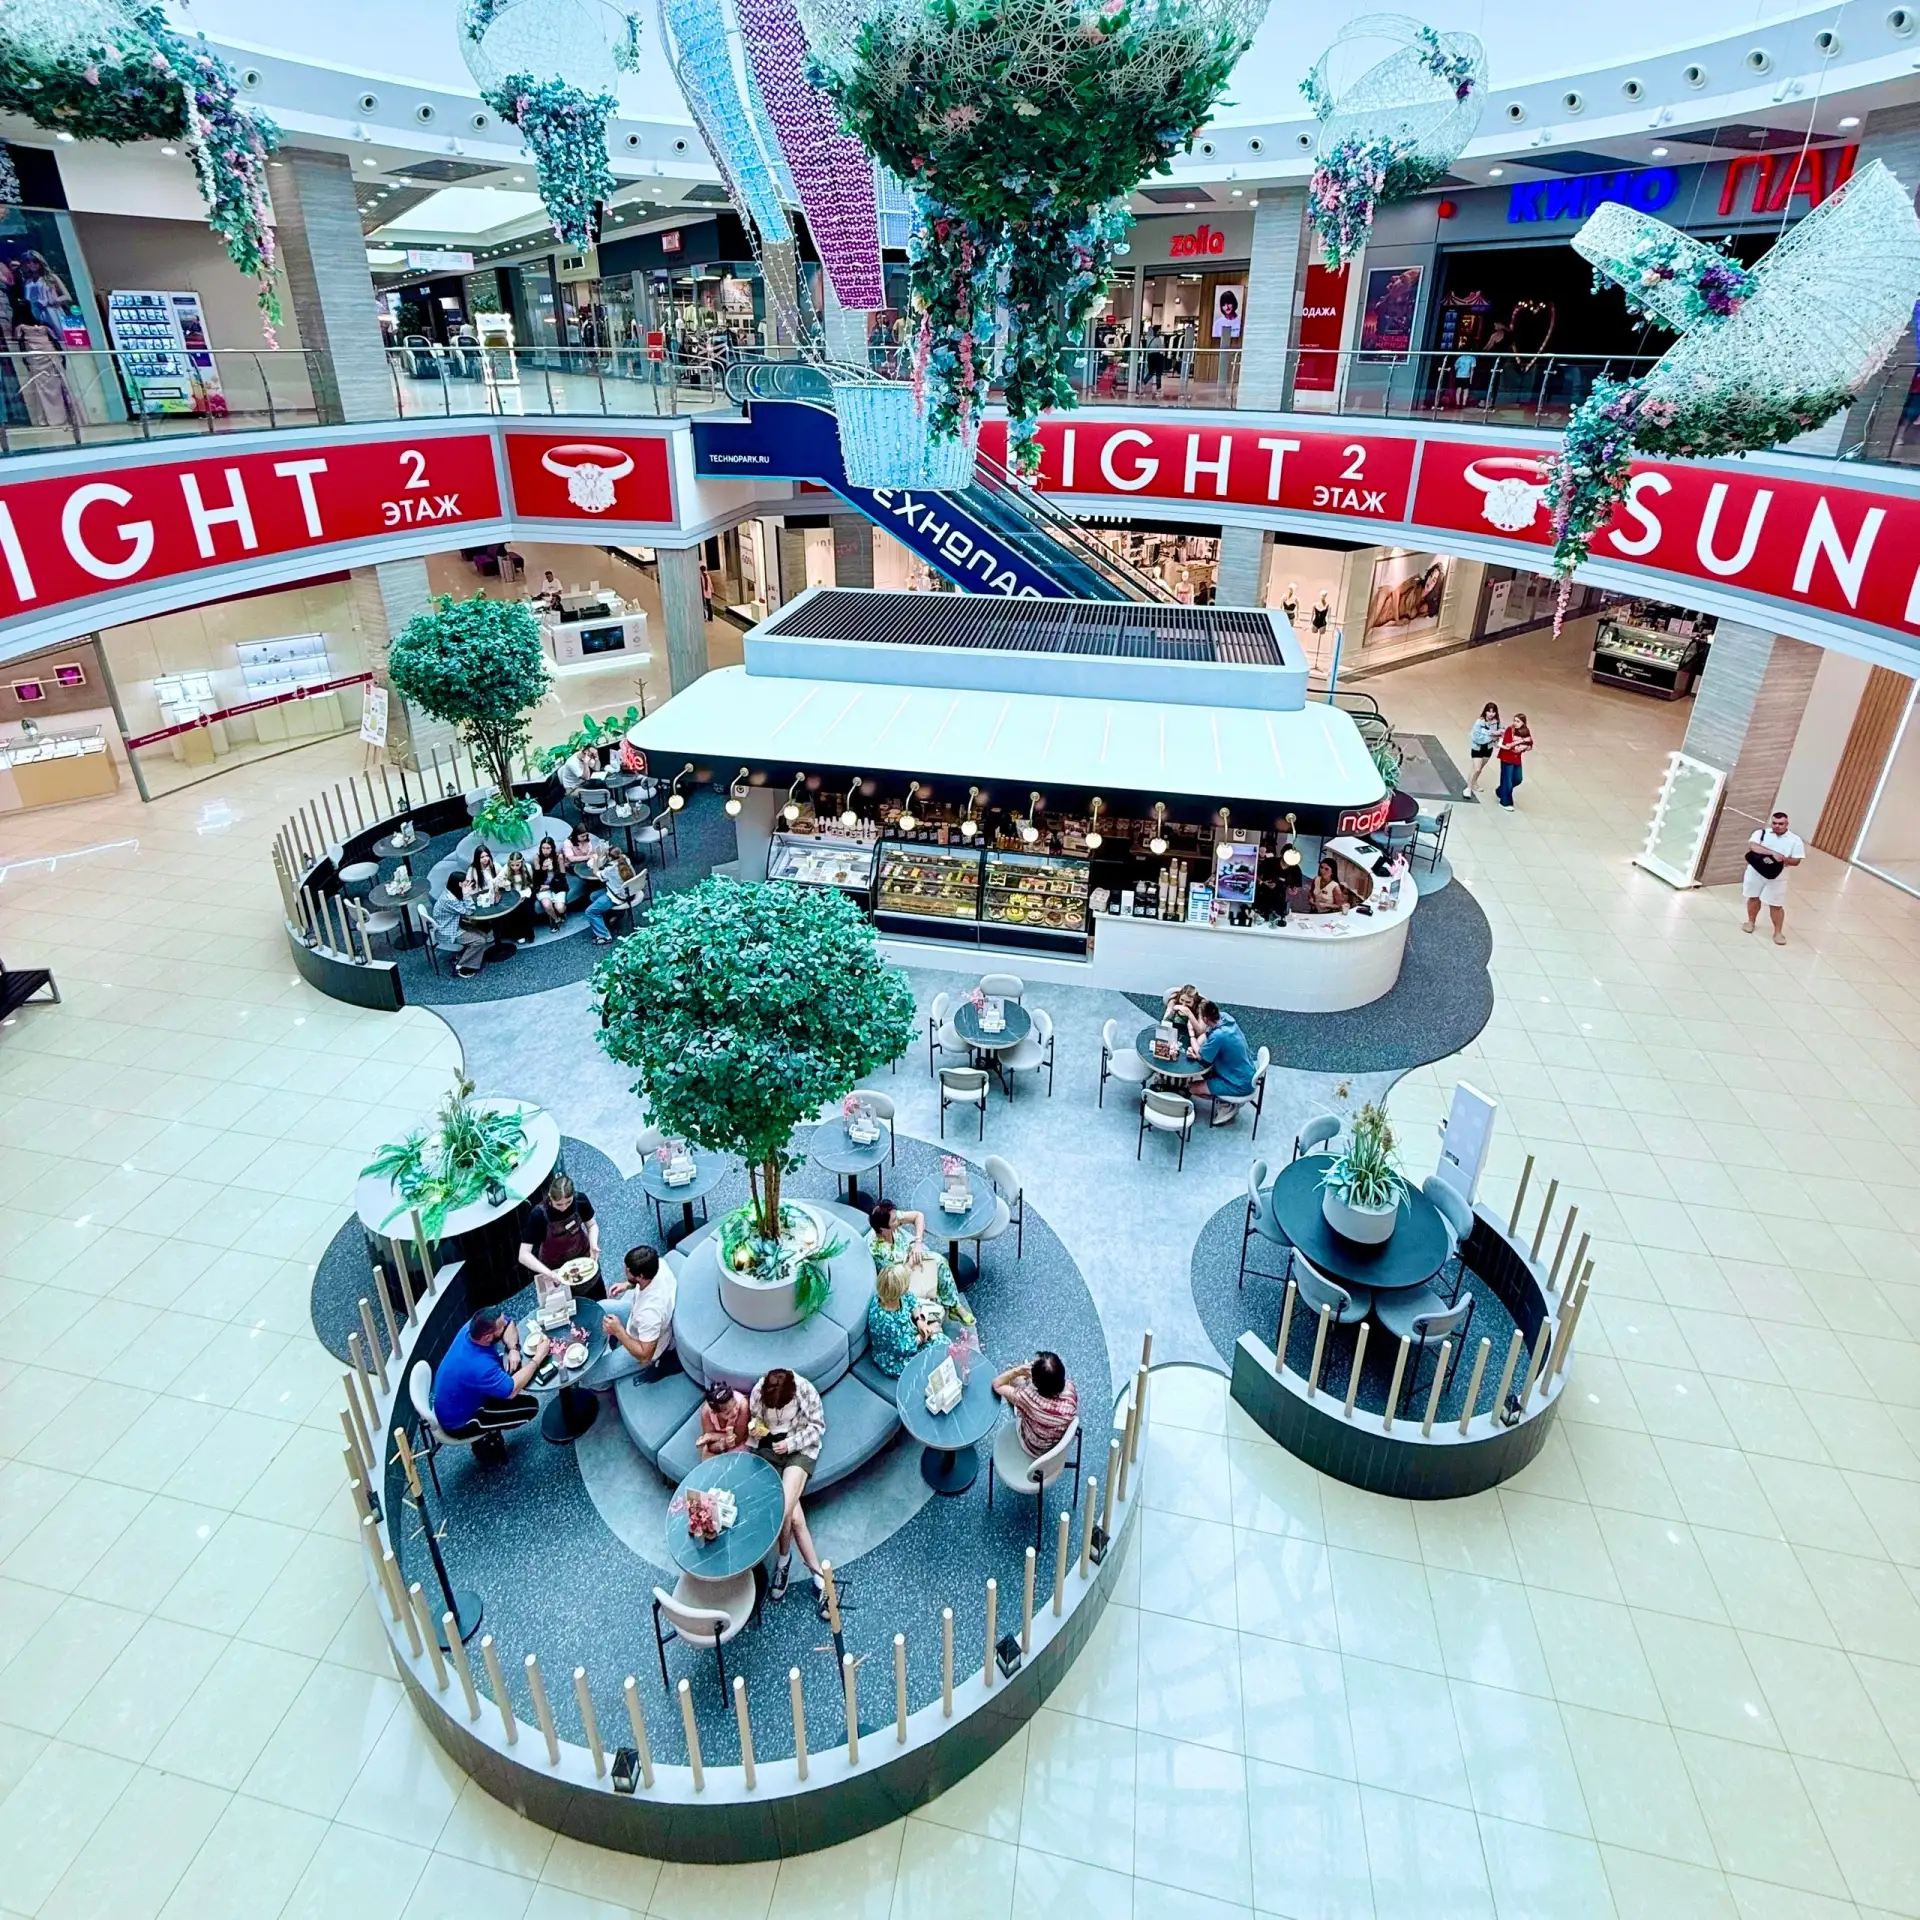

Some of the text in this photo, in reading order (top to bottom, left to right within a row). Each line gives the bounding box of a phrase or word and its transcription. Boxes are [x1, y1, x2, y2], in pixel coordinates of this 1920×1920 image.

[1507, 166, 1680, 223] КИНО
[1169, 223, 1225, 257] zolla
[399, 449, 431, 489] 2
[708, 453, 771, 464] TECHNOPARK.RU
[1339, 443, 1367, 481] 2
[381, 493, 463, 526] ЭТАЖ
[1312, 485, 1388, 514] ЭТАЖ
